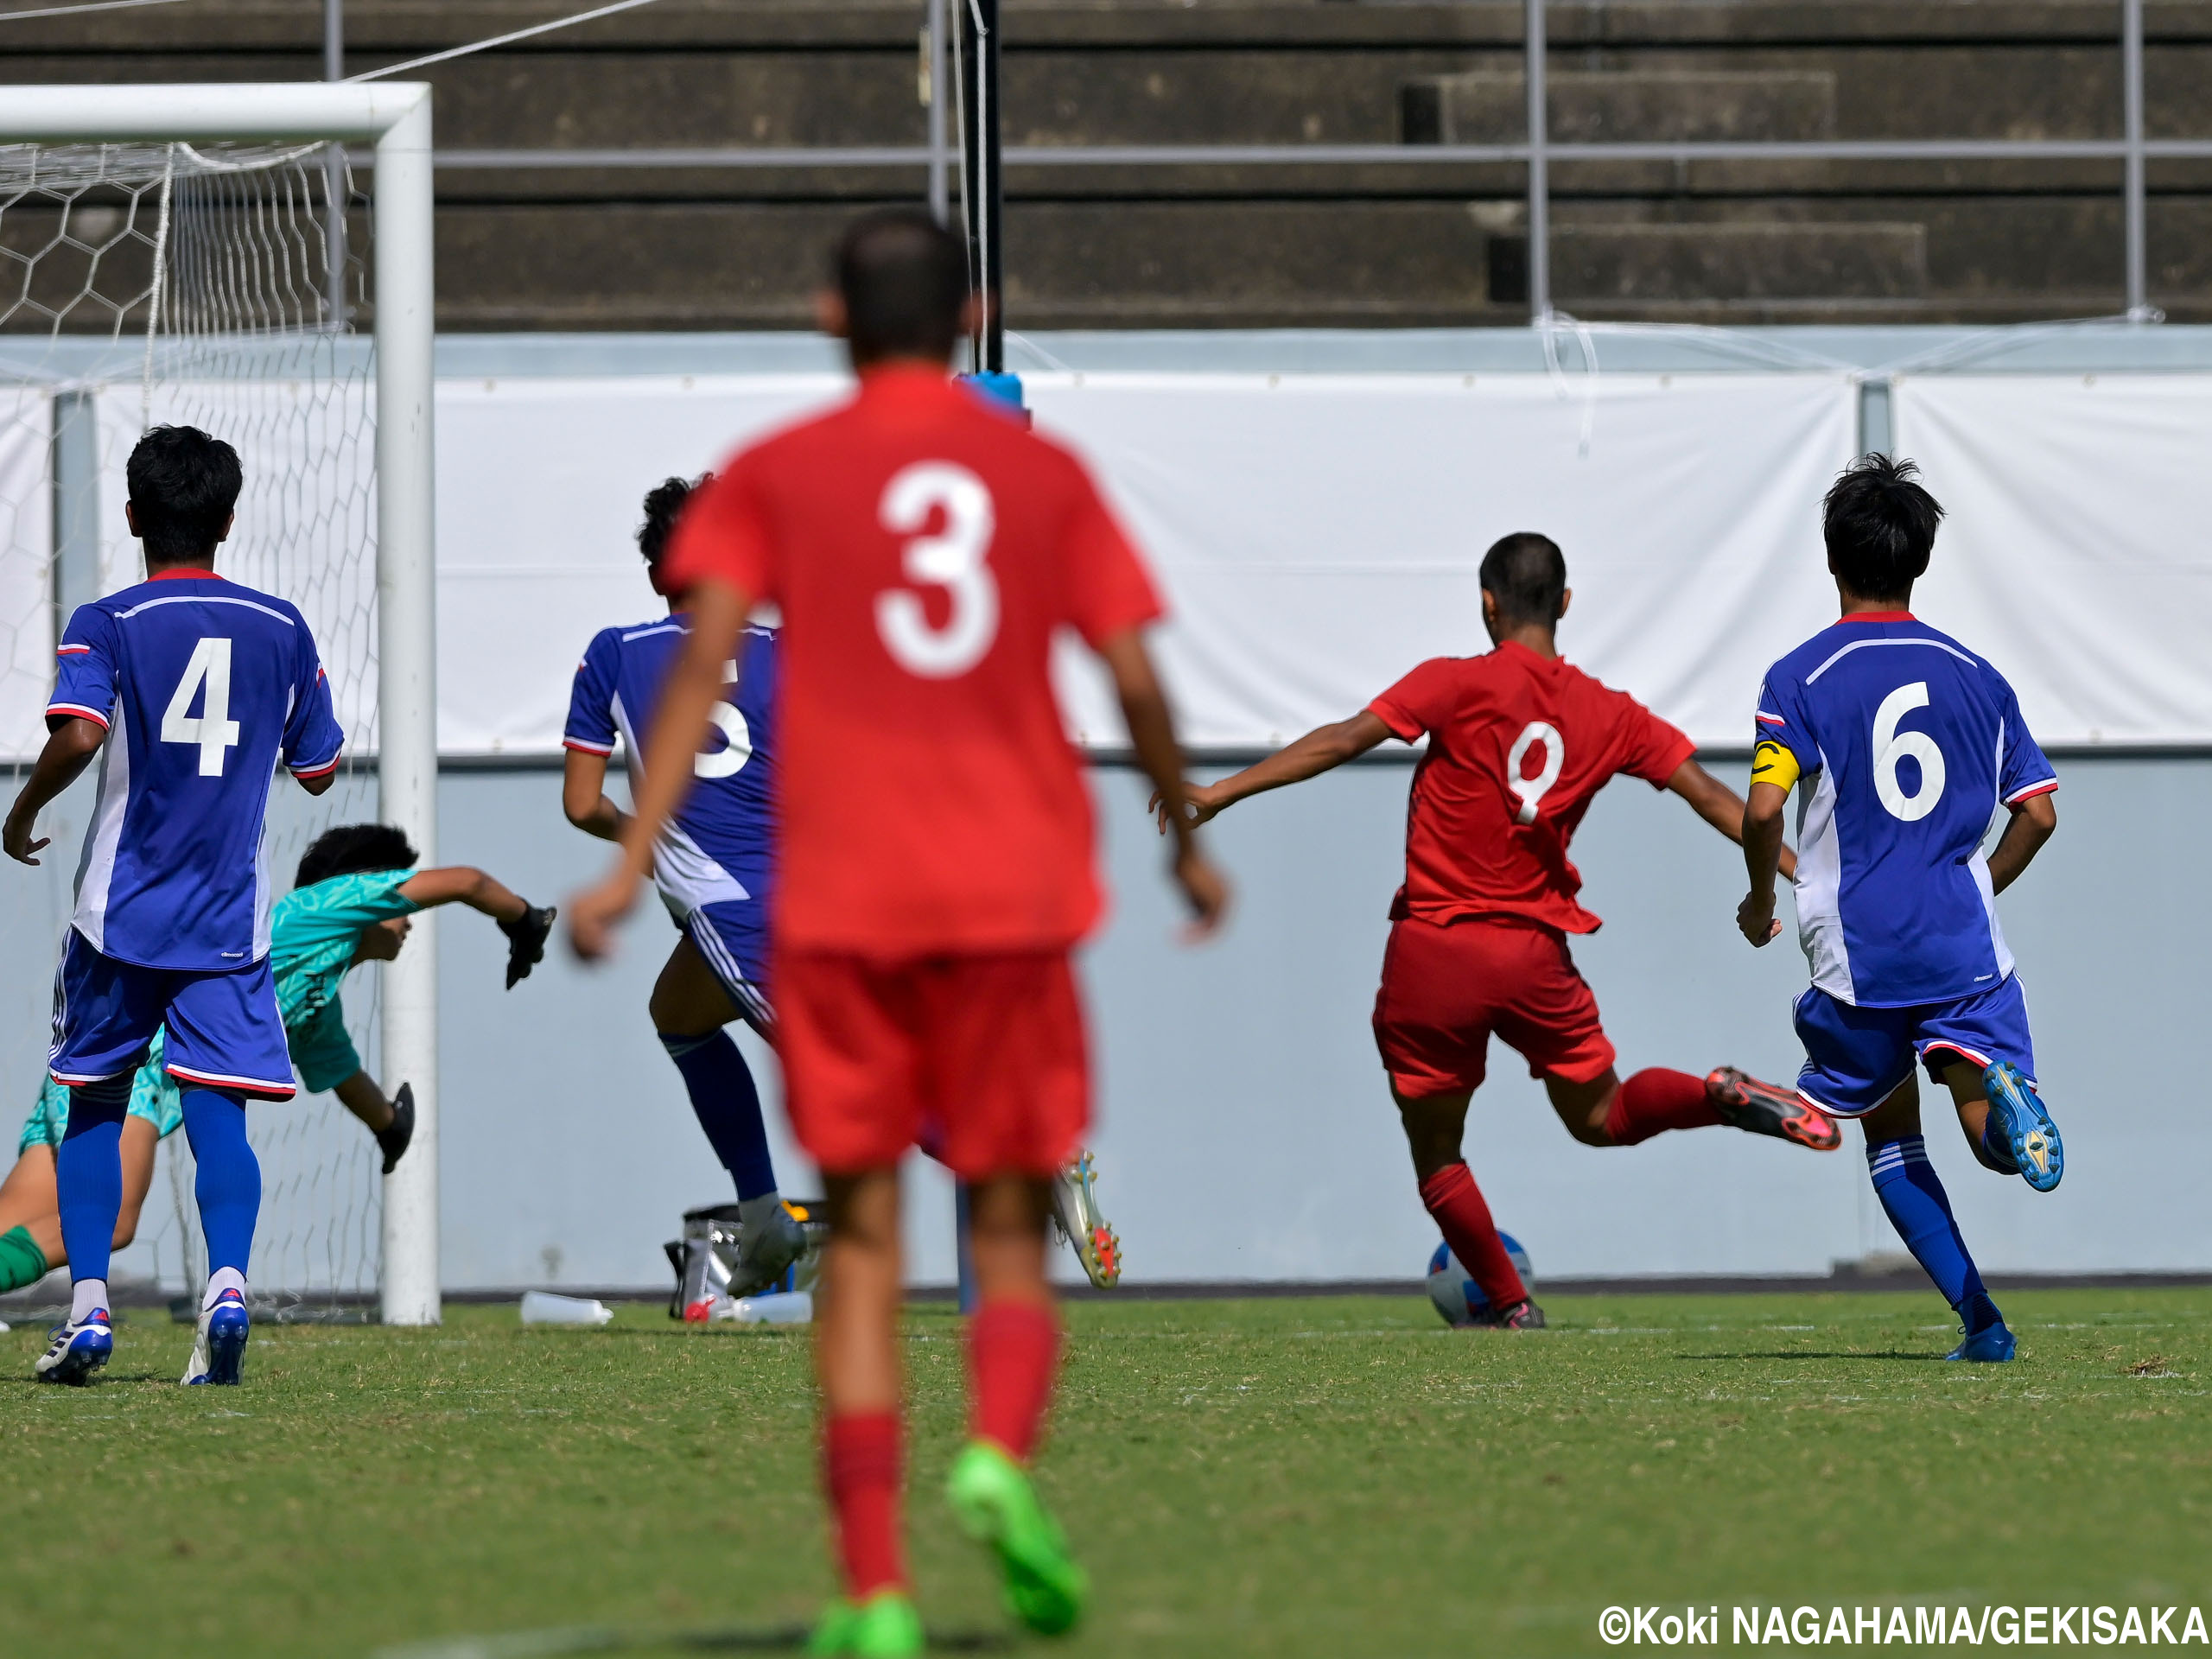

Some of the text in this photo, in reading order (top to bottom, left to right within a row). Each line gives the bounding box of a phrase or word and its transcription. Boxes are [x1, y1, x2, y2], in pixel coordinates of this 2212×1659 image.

[875, 461, 999, 677] 3
[160, 637, 240, 777] 4
[1507, 721, 1565, 825] 9
[1872, 681, 1946, 822] 6
